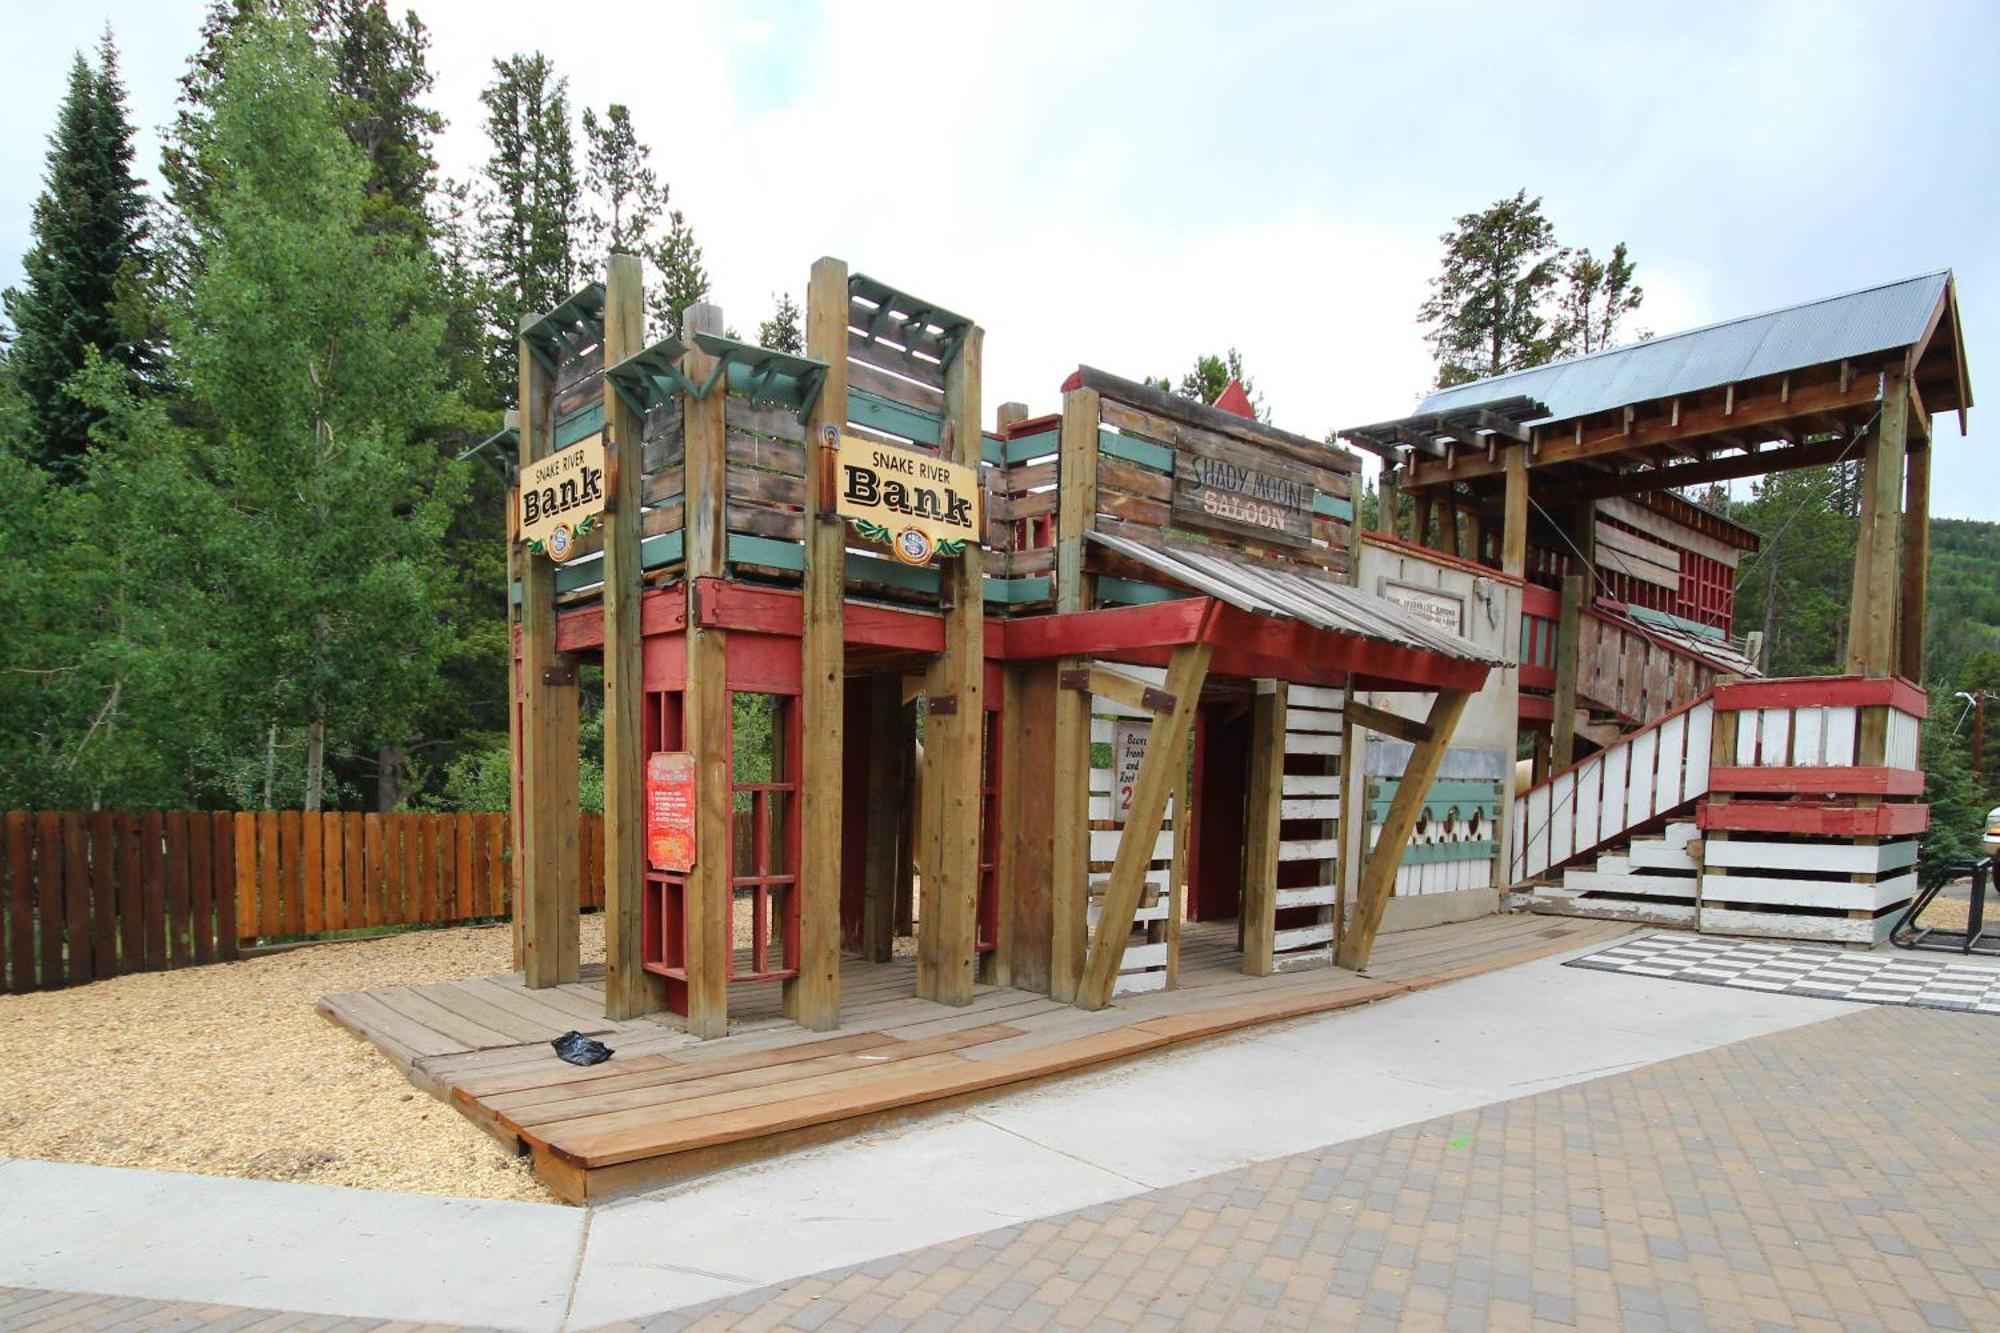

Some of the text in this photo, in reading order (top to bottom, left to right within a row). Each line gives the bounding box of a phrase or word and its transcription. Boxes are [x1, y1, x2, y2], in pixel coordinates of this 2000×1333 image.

[535, 449, 585, 484] SNAKE RIVER
[872, 451, 950, 484] SNAKE RIVER
[1192, 455, 1301, 516] SHADY MOON
[523, 466, 602, 527] Bank
[843, 464, 973, 528] Bank
[1203, 490, 1287, 530] SALOON
